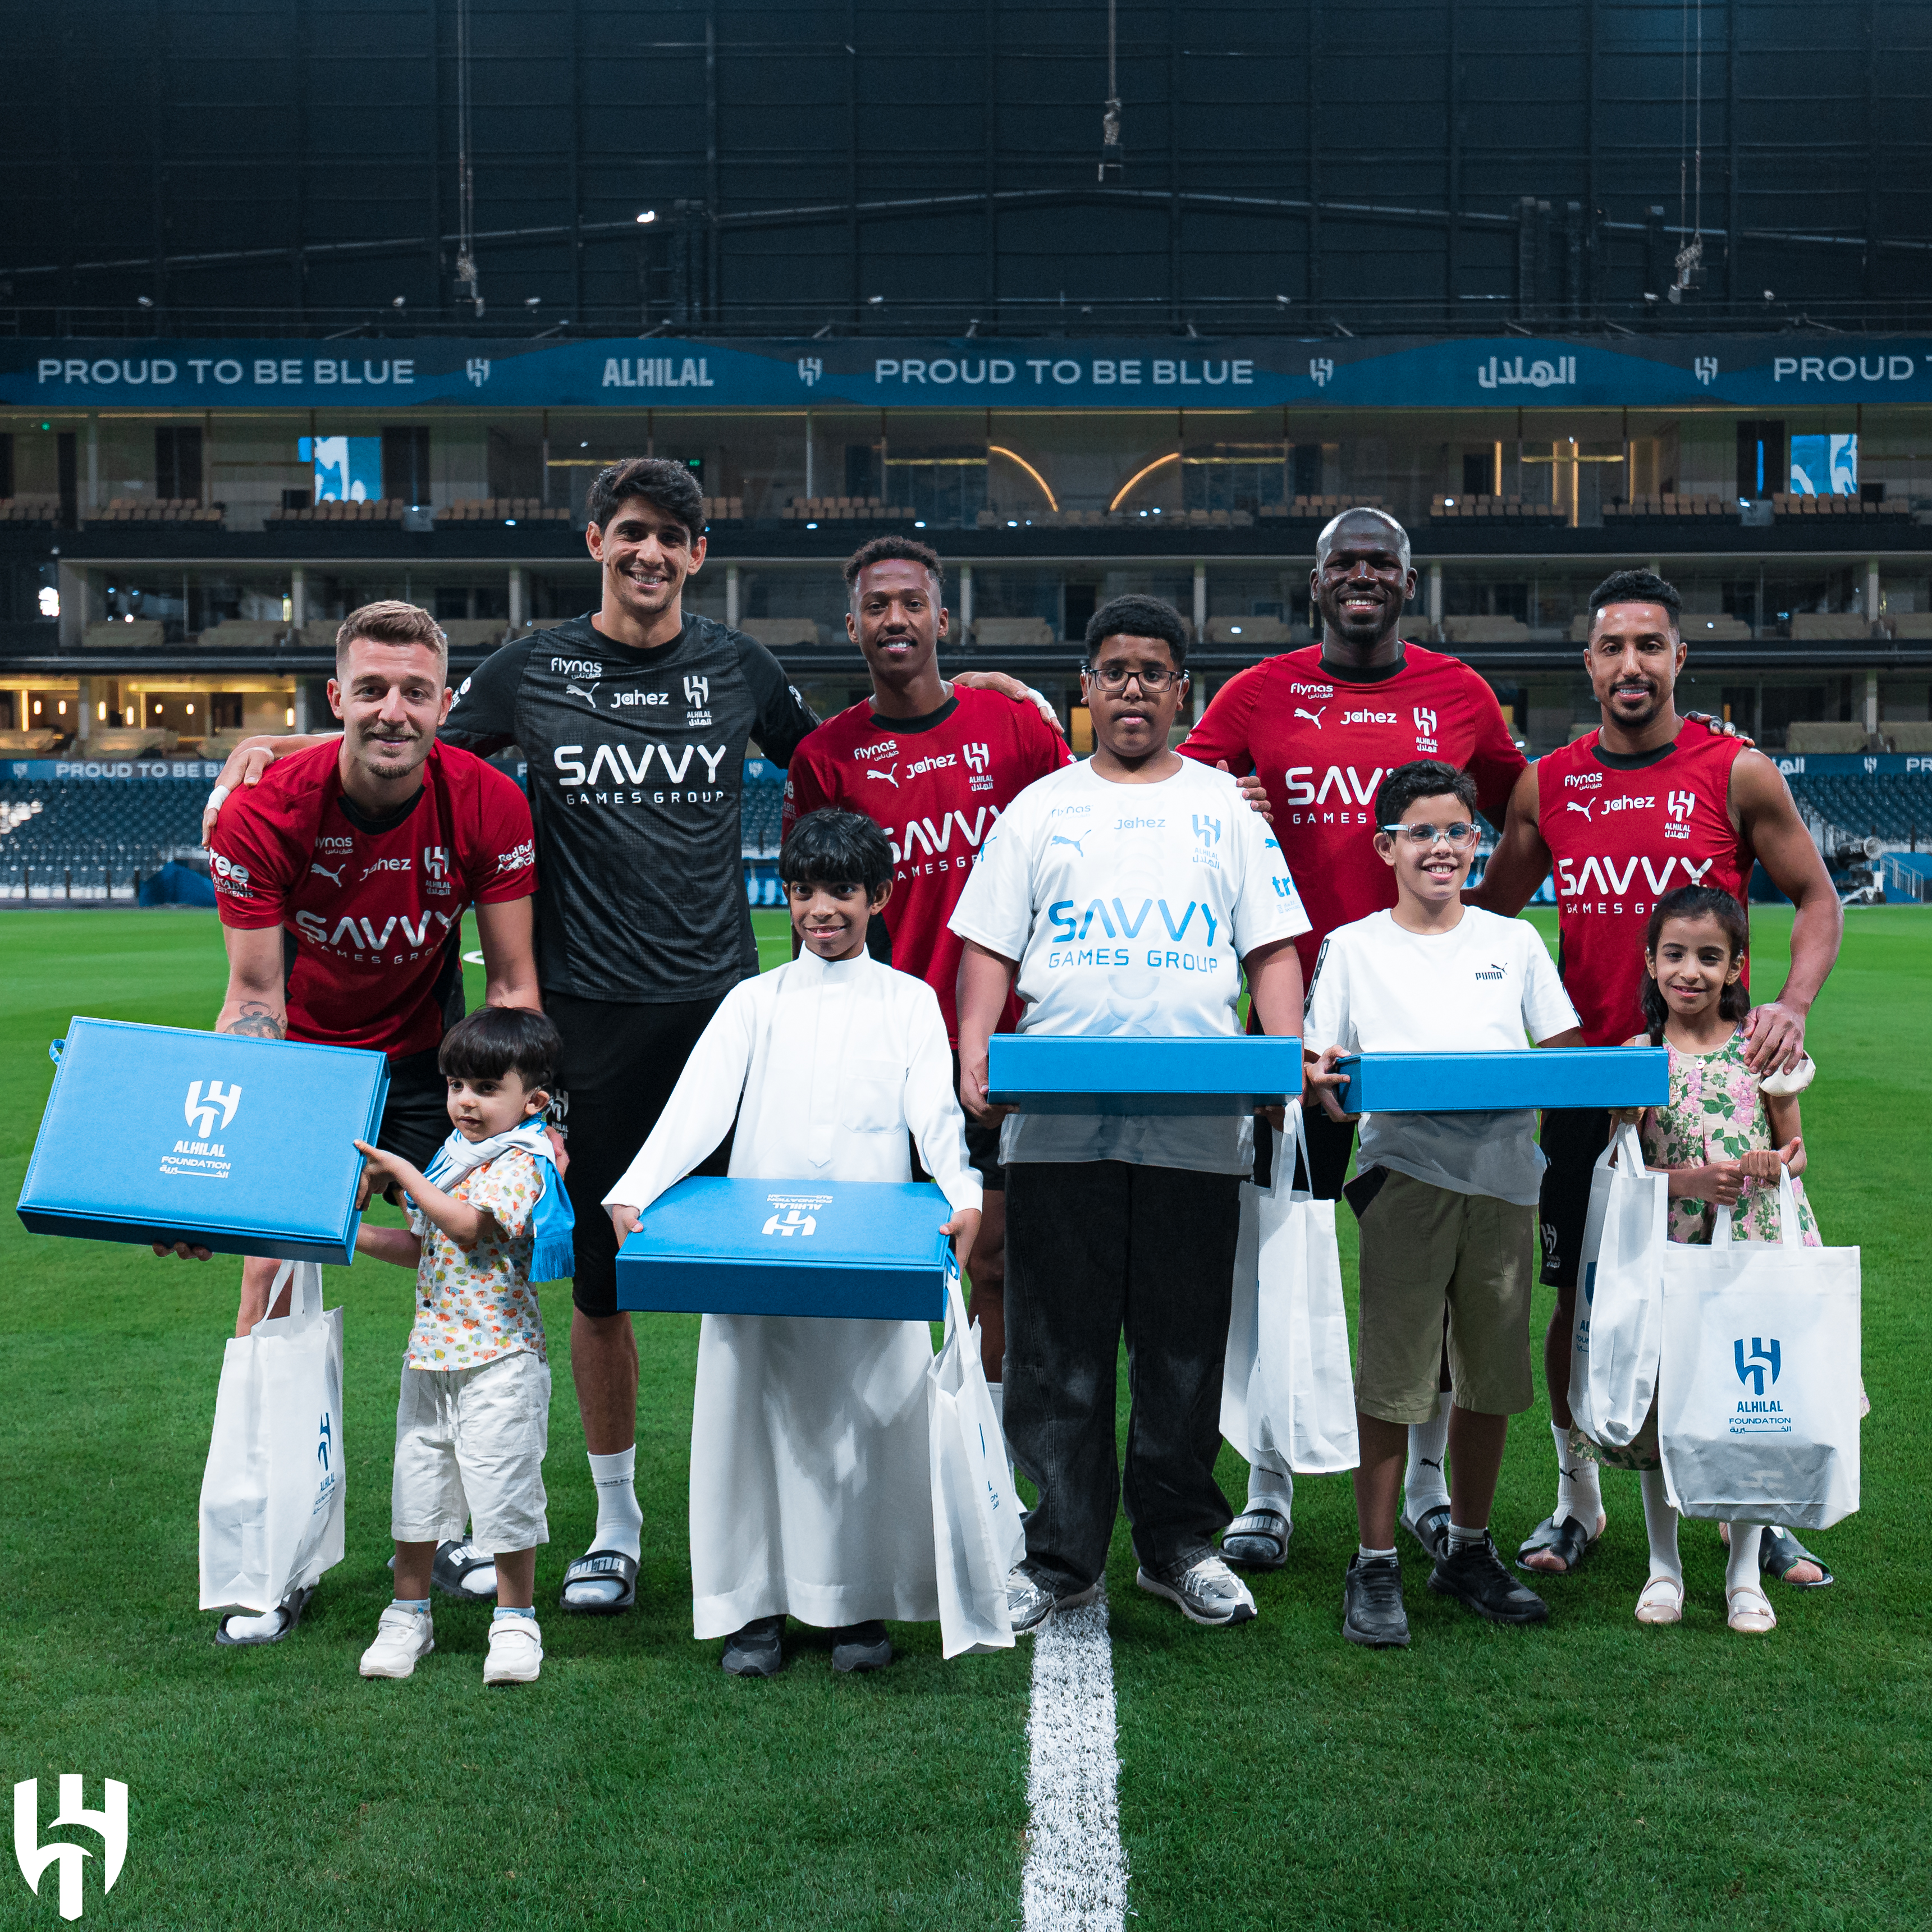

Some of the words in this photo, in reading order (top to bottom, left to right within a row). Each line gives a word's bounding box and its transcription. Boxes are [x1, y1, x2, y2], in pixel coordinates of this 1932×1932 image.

[38, 359, 177, 384] PROUD
[187, 359, 243, 384] TO
[254, 359, 303, 384] BE
[313, 359, 414, 384] BLUE
[602, 357, 714, 387] ALHILAL
[875, 359, 1015, 384] PROUD
[1026, 359, 1081, 384] TO
[1092, 359, 1141, 384] BE
[1152, 359, 1253, 384] BLUE
[1478, 356, 1576, 388] الهلال
[1774, 356, 1915, 382] PROUD
[551, 657, 602, 674] flynas
[1290, 683, 1334, 695] flynas
[688, 718, 712, 726] الهلال
[1416, 736, 1438, 747] ALHILAL
[1417, 744, 1437, 753] الهلال
[854, 740, 896, 760] flynas
[56, 762, 133, 778] PROUD
[138, 762, 168, 778] TO
[172, 762, 199, 778] BE
[554, 744, 726, 786] SAVVY
[969, 775, 994, 784] ALHILAL
[971, 782, 994, 791] الهلال
[1285, 765, 1394, 805] SAV
[1564, 772, 1603, 788] flynas
[566, 791, 642, 805] GAMES
[654, 791, 724, 804] GROUP
[1051, 805, 1091, 818] flynas
[1293, 812, 1367, 824] GAMES
[1664, 830, 1690, 839] الهلال
[1665, 822, 1691, 832] ALHILAL
[315, 835, 353, 849] lynas
[498, 846, 519, 863] Red
[518, 839, 533, 855] Bull
[1194, 848, 1219, 860] ALHILAL
[209, 846, 249, 883] ree
[1192, 854, 1220, 870] الهلال
[897, 860, 949, 881] AMES
[1558, 856, 1713, 896] SAVVY
[296, 903, 463, 950] SAVVY
[1048, 898, 1217, 947] SAVVY
[1049, 948, 1129, 969] GAMES
[1147, 950, 1217, 974] GROUP
[1475, 972, 1503, 981] PUMA
[173, 1140, 226, 1158] ALHILAL
[161, 1155, 232, 1170] FOUNDATION
[772, 1202, 823, 1211] ALHILAL
[1737, 1400, 1784, 1413] ALHILAL
[1228, 1516, 1283, 1534] PUMA
[568, 1556, 625, 1578] PUMA
